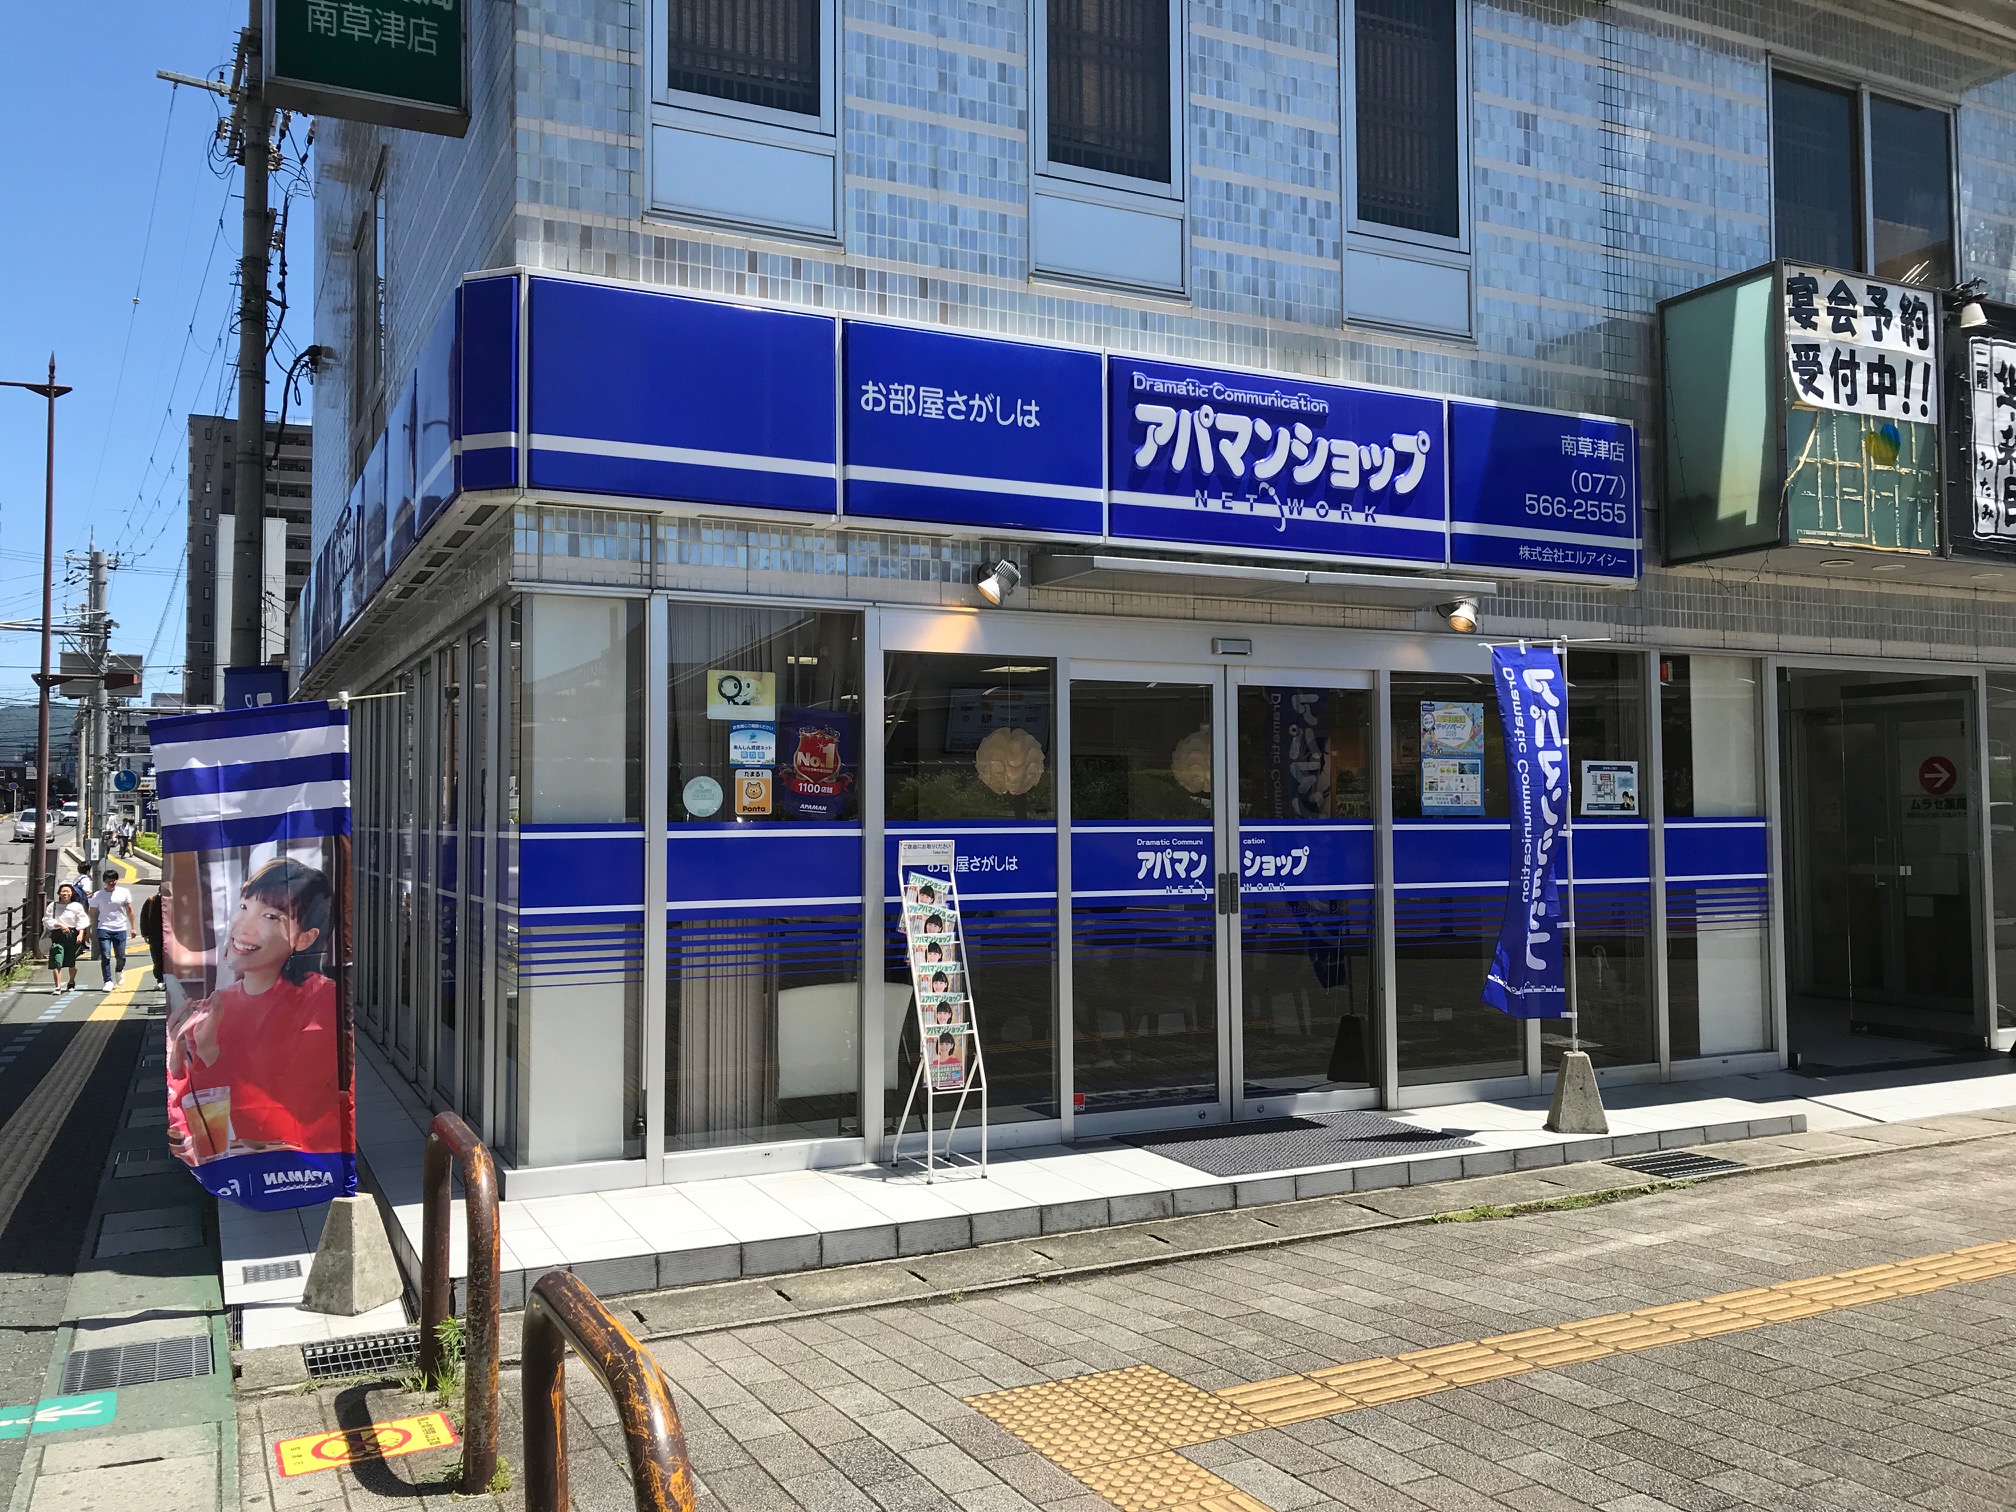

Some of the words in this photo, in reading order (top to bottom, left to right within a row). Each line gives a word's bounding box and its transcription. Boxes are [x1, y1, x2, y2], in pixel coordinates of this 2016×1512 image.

[307, 0, 439, 56] 南草津店
[1786, 273, 1930, 351] 宴会予約
[860, 380, 1041, 428] お部屋さがしは
[1133, 373, 1209, 398] Dramatic
[1212, 381, 1329, 414] Communication
[1134, 404, 1431, 495] アパマンショップ
[1560, 434, 1625, 462] 南草津店
[1571, 469, 1626, 498] (077)
[1979, 450, 1995, 522] わたみ
[1525, 493, 1627, 524] 566-2555
[1519, 545, 1627, 567] 株式会社エルアイシー
[797, 743, 836, 769] No.1
[800, 803, 827, 811] APAMAN
[1136, 838, 1170, 846] Dramatic
[1172, 838, 1204, 846] Communi
[1243, 837, 1265, 845] cation
[1137, 849, 1207, 880] アパマン
[1243, 845, 1310, 877] ショップ
